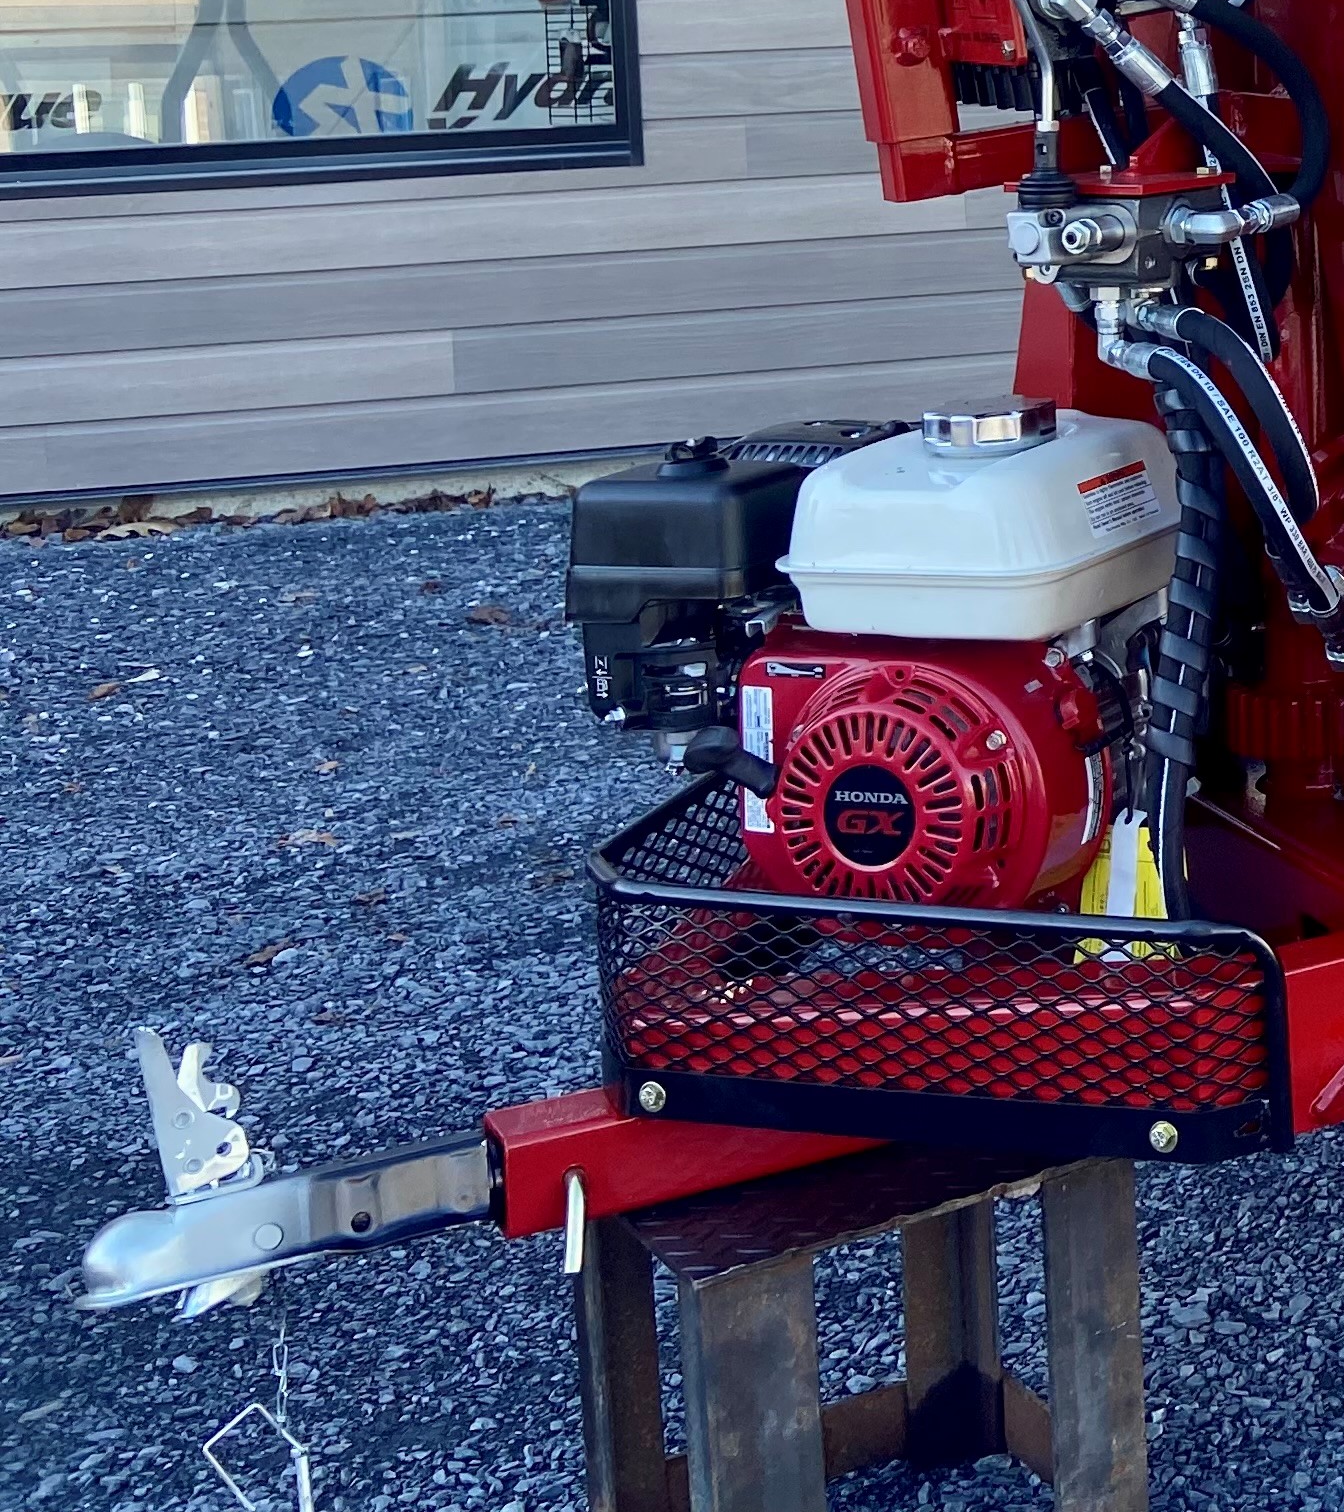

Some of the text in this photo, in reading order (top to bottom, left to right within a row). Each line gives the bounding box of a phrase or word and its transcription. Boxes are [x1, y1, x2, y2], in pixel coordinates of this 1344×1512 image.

[1217, 399, 1235, 423] SAE
[1234, 425, 1250, 446] 100
[1247, 449, 1270, 482] R2AT
[1280, 506, 1292, 524] WP
[834, 790, 909, 805] HONDA
[837, 809, 904, 836] GX
